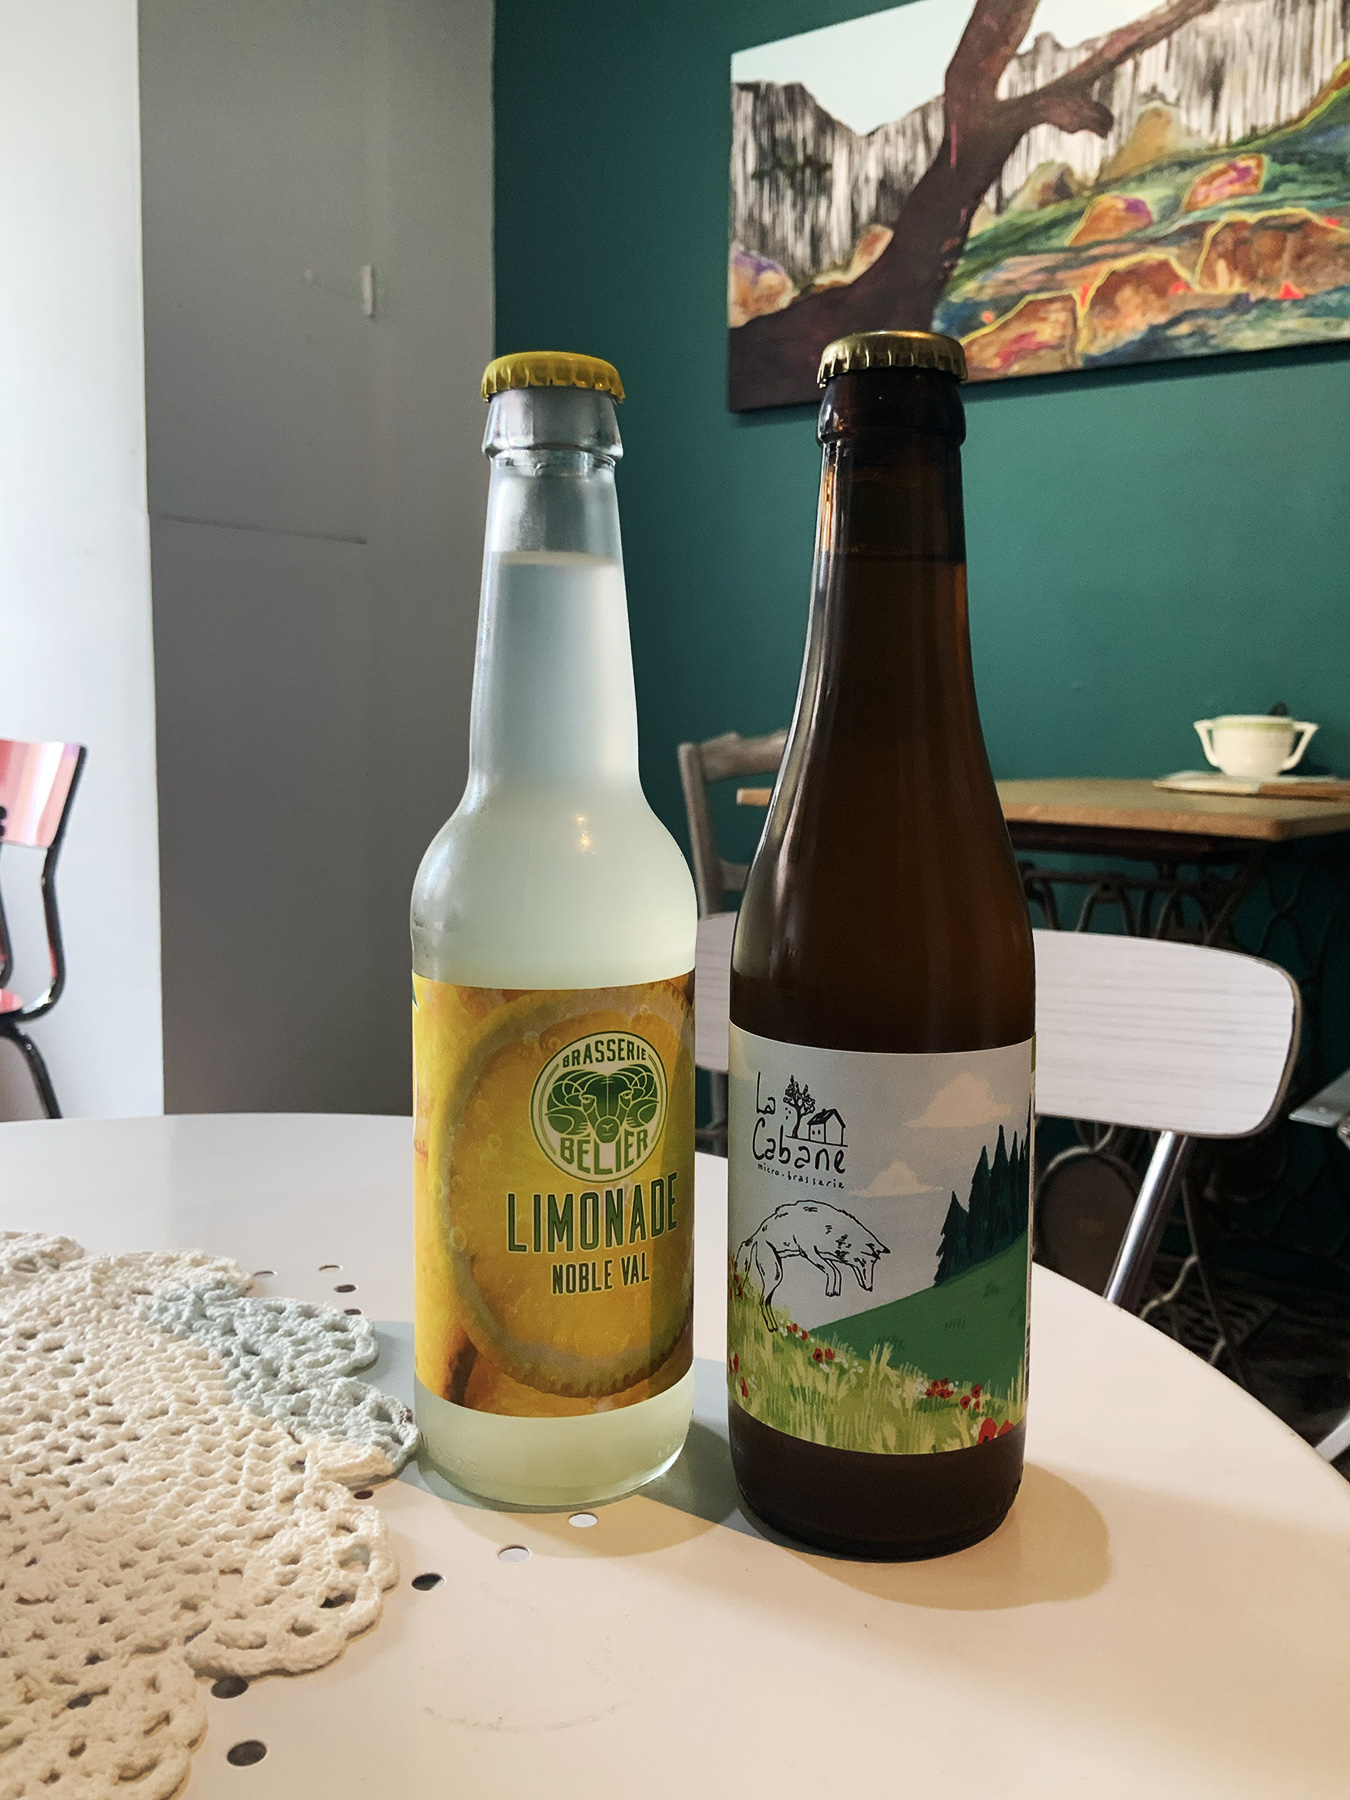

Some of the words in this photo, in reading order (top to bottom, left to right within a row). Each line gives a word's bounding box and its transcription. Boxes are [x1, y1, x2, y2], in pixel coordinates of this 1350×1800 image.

[562, 1038, 647, 1069] BRASSERIE
[756, 1071, 776, 1115] La
[752, 1116, 846, 1174] Cabane
[507, 1171, 678, 1253] LIMONADE
[552, 1259, 613, 1295] NOBLE
[620, 1251, 650, 1287] VAL
